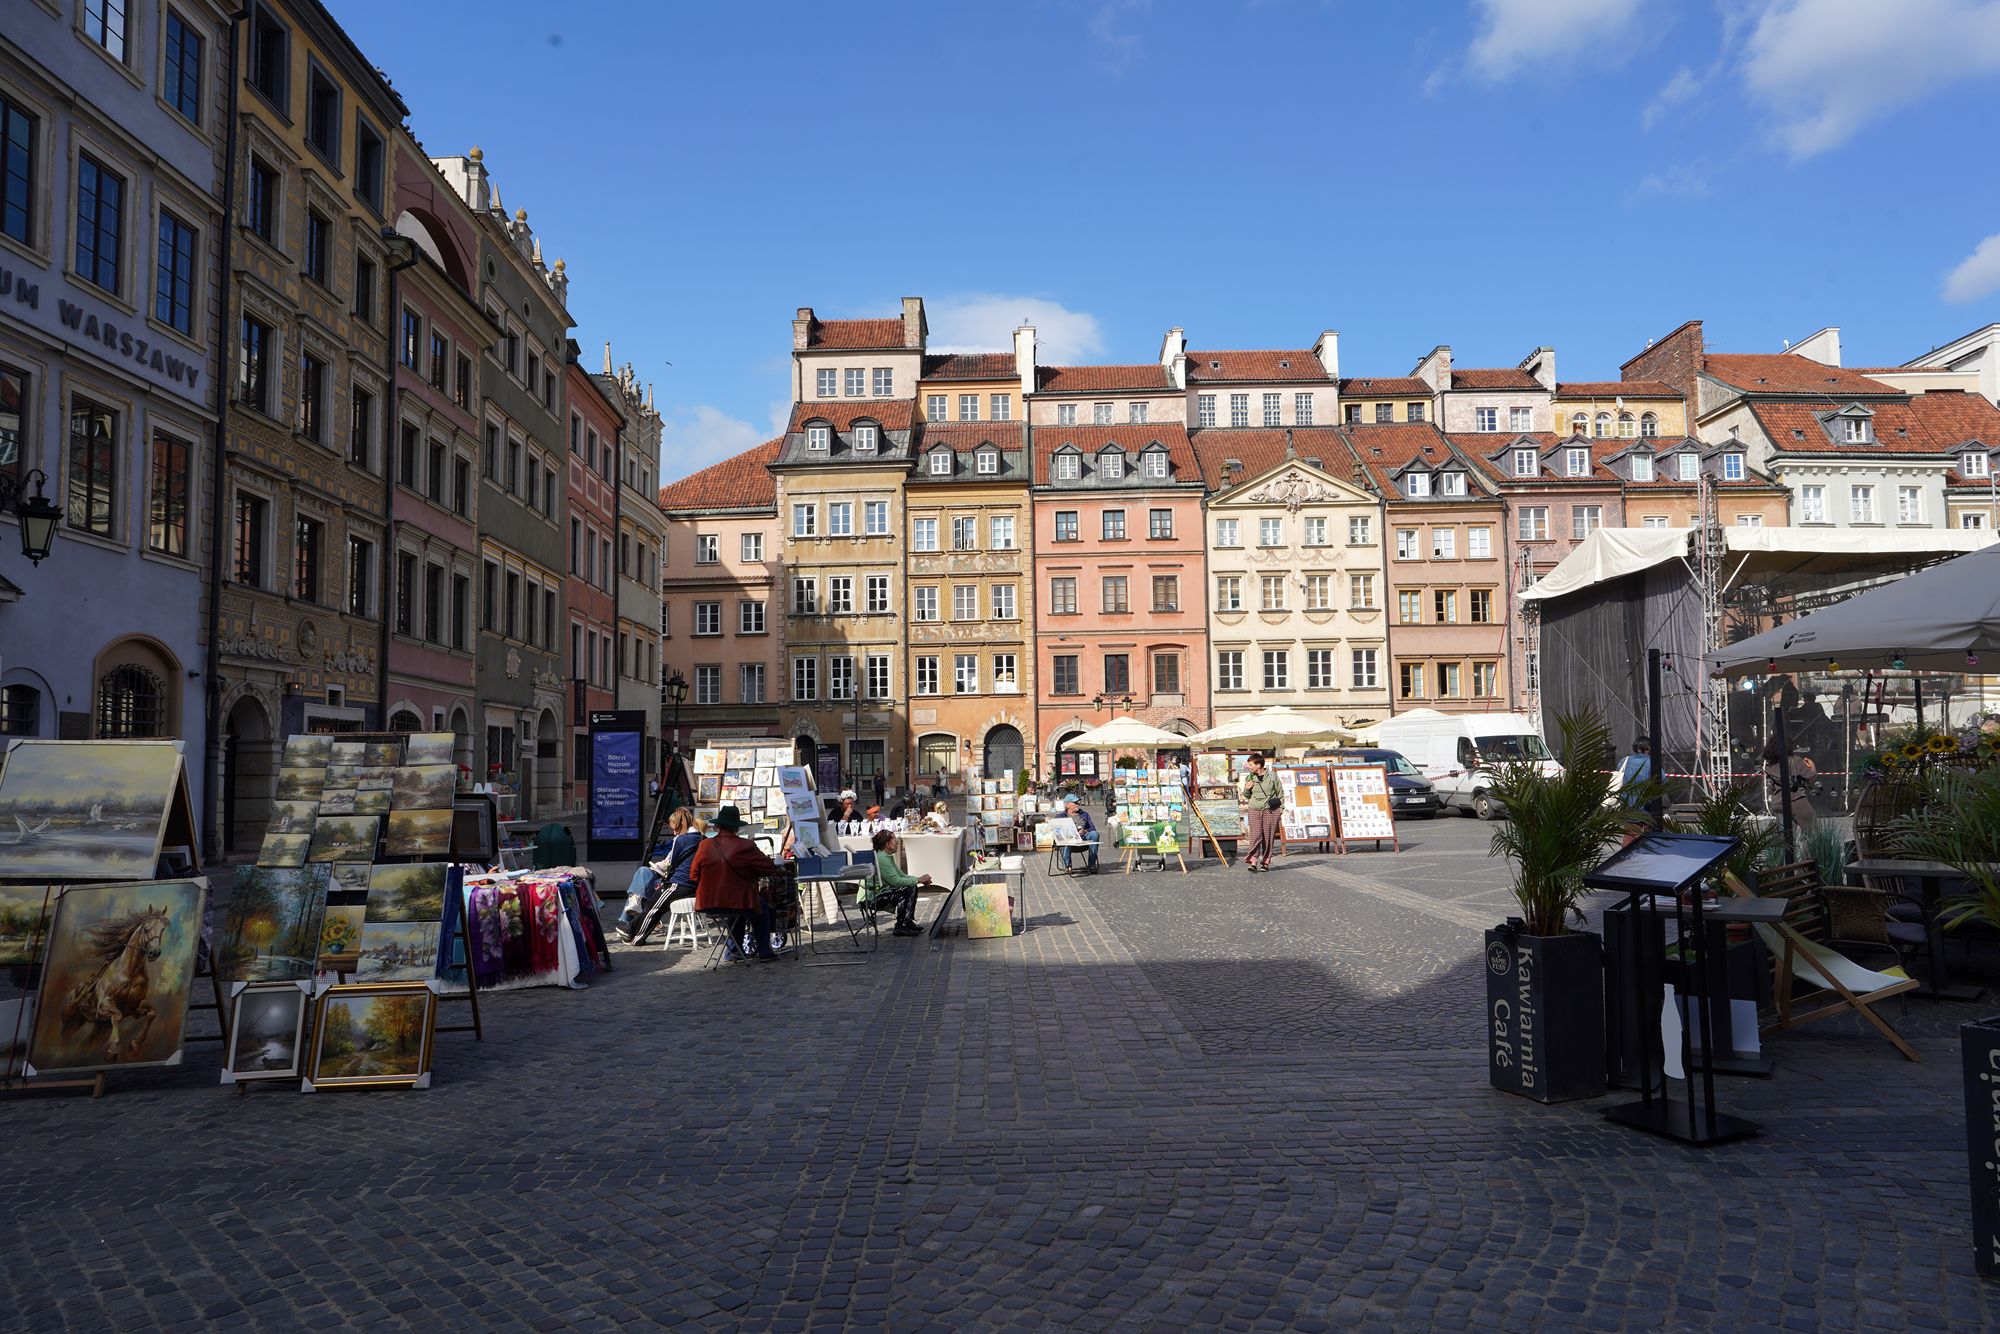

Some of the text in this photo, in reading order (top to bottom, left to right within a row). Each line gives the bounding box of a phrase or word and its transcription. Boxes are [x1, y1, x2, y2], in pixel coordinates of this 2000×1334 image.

[58, 299, 200, 389] WARSZAWY
[1494, 998, 1513, 1068] Café
[1518, 946, 1538, 1088] Kawiarnia
